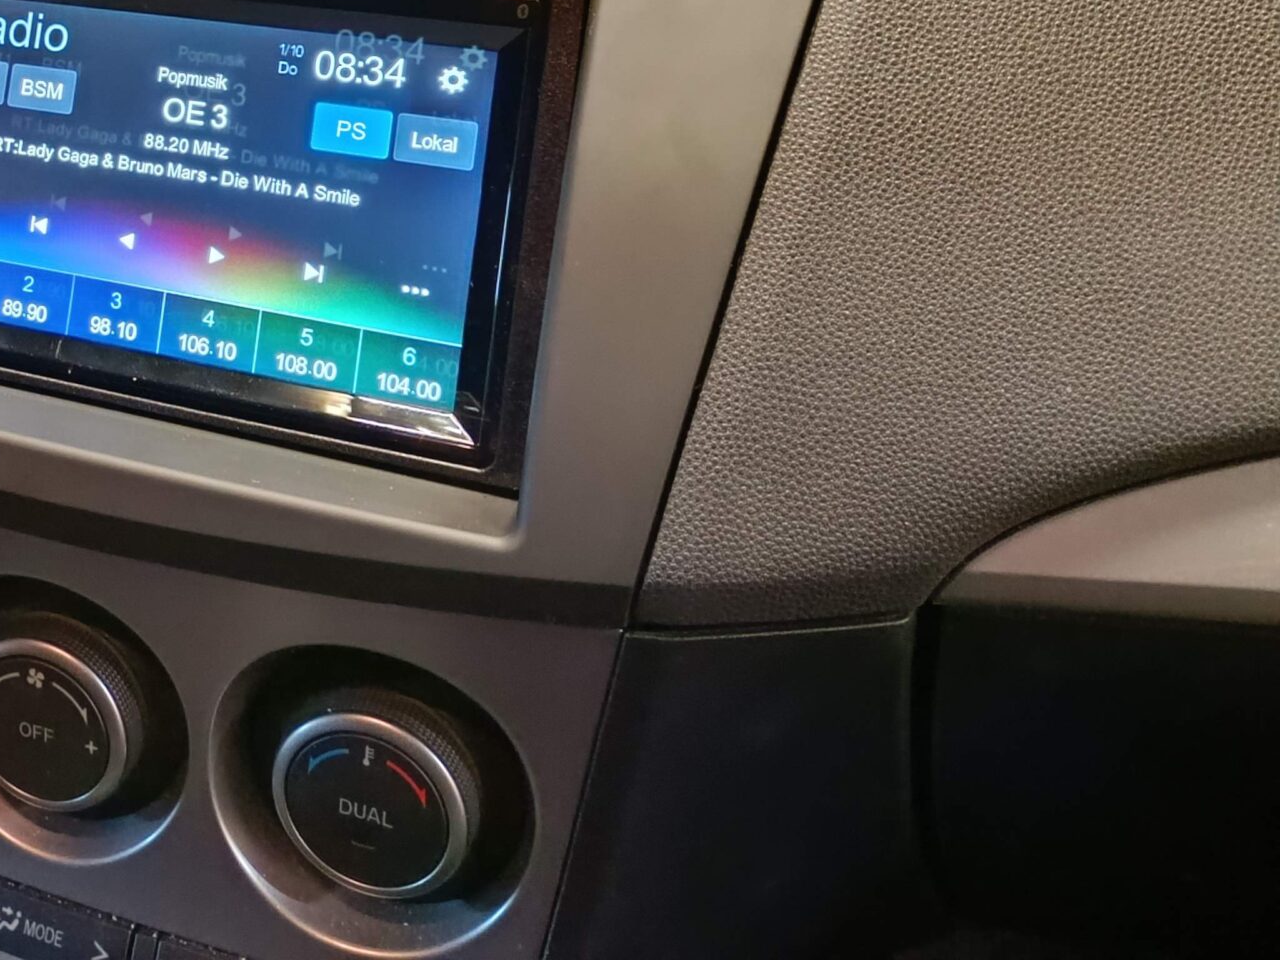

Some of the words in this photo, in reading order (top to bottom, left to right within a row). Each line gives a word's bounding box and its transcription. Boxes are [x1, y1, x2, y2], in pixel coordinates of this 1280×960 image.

[278, 43, 305, 58] 1/10
[157, 66, 229, 91] Popmusik
[277, 61, 299, 76] Do
[315, 50, 407, 89] 08:34
[19, 78, 65, 101] BSM
[210, 103, 229, 130] 3
[335, 119, 367, 141] PS
[410, 131, 459, 154] Lokal
[143, 132, 190, 154] 88.20
[192, 139, 230, 160] MHz
[57, 146, 99, 168] Gaga
[102, 153, 114, 169] &
[118, 155, 164, 177] Bruno
[166, 162, 208, 183] Mars
[221, 170, 249, 190] Die
[253, 174, 292, 197] With
[294, 183, 310, 199] A
[313, 184, 361, 208] Smile
[21, 275, 35, 293] 2
[1, 298, 48, 323] 89.90
[110, 291, 123, 310] 3
[89, 315, 138, 341] 98.10
[201, 309, 216, 329] 4
[178, 333, 237, 362] 106.10
[299, 327, 314, 347] 5
[275, 352, 338, 382] 108.00
[402, 346, 417, 367] 6
[376, 371, 442, 402] 104.00
[19, 721, 55, 743] OFF
[339, 797, 393, 829] DUAL
[23, 918, 64, 949] MODE
